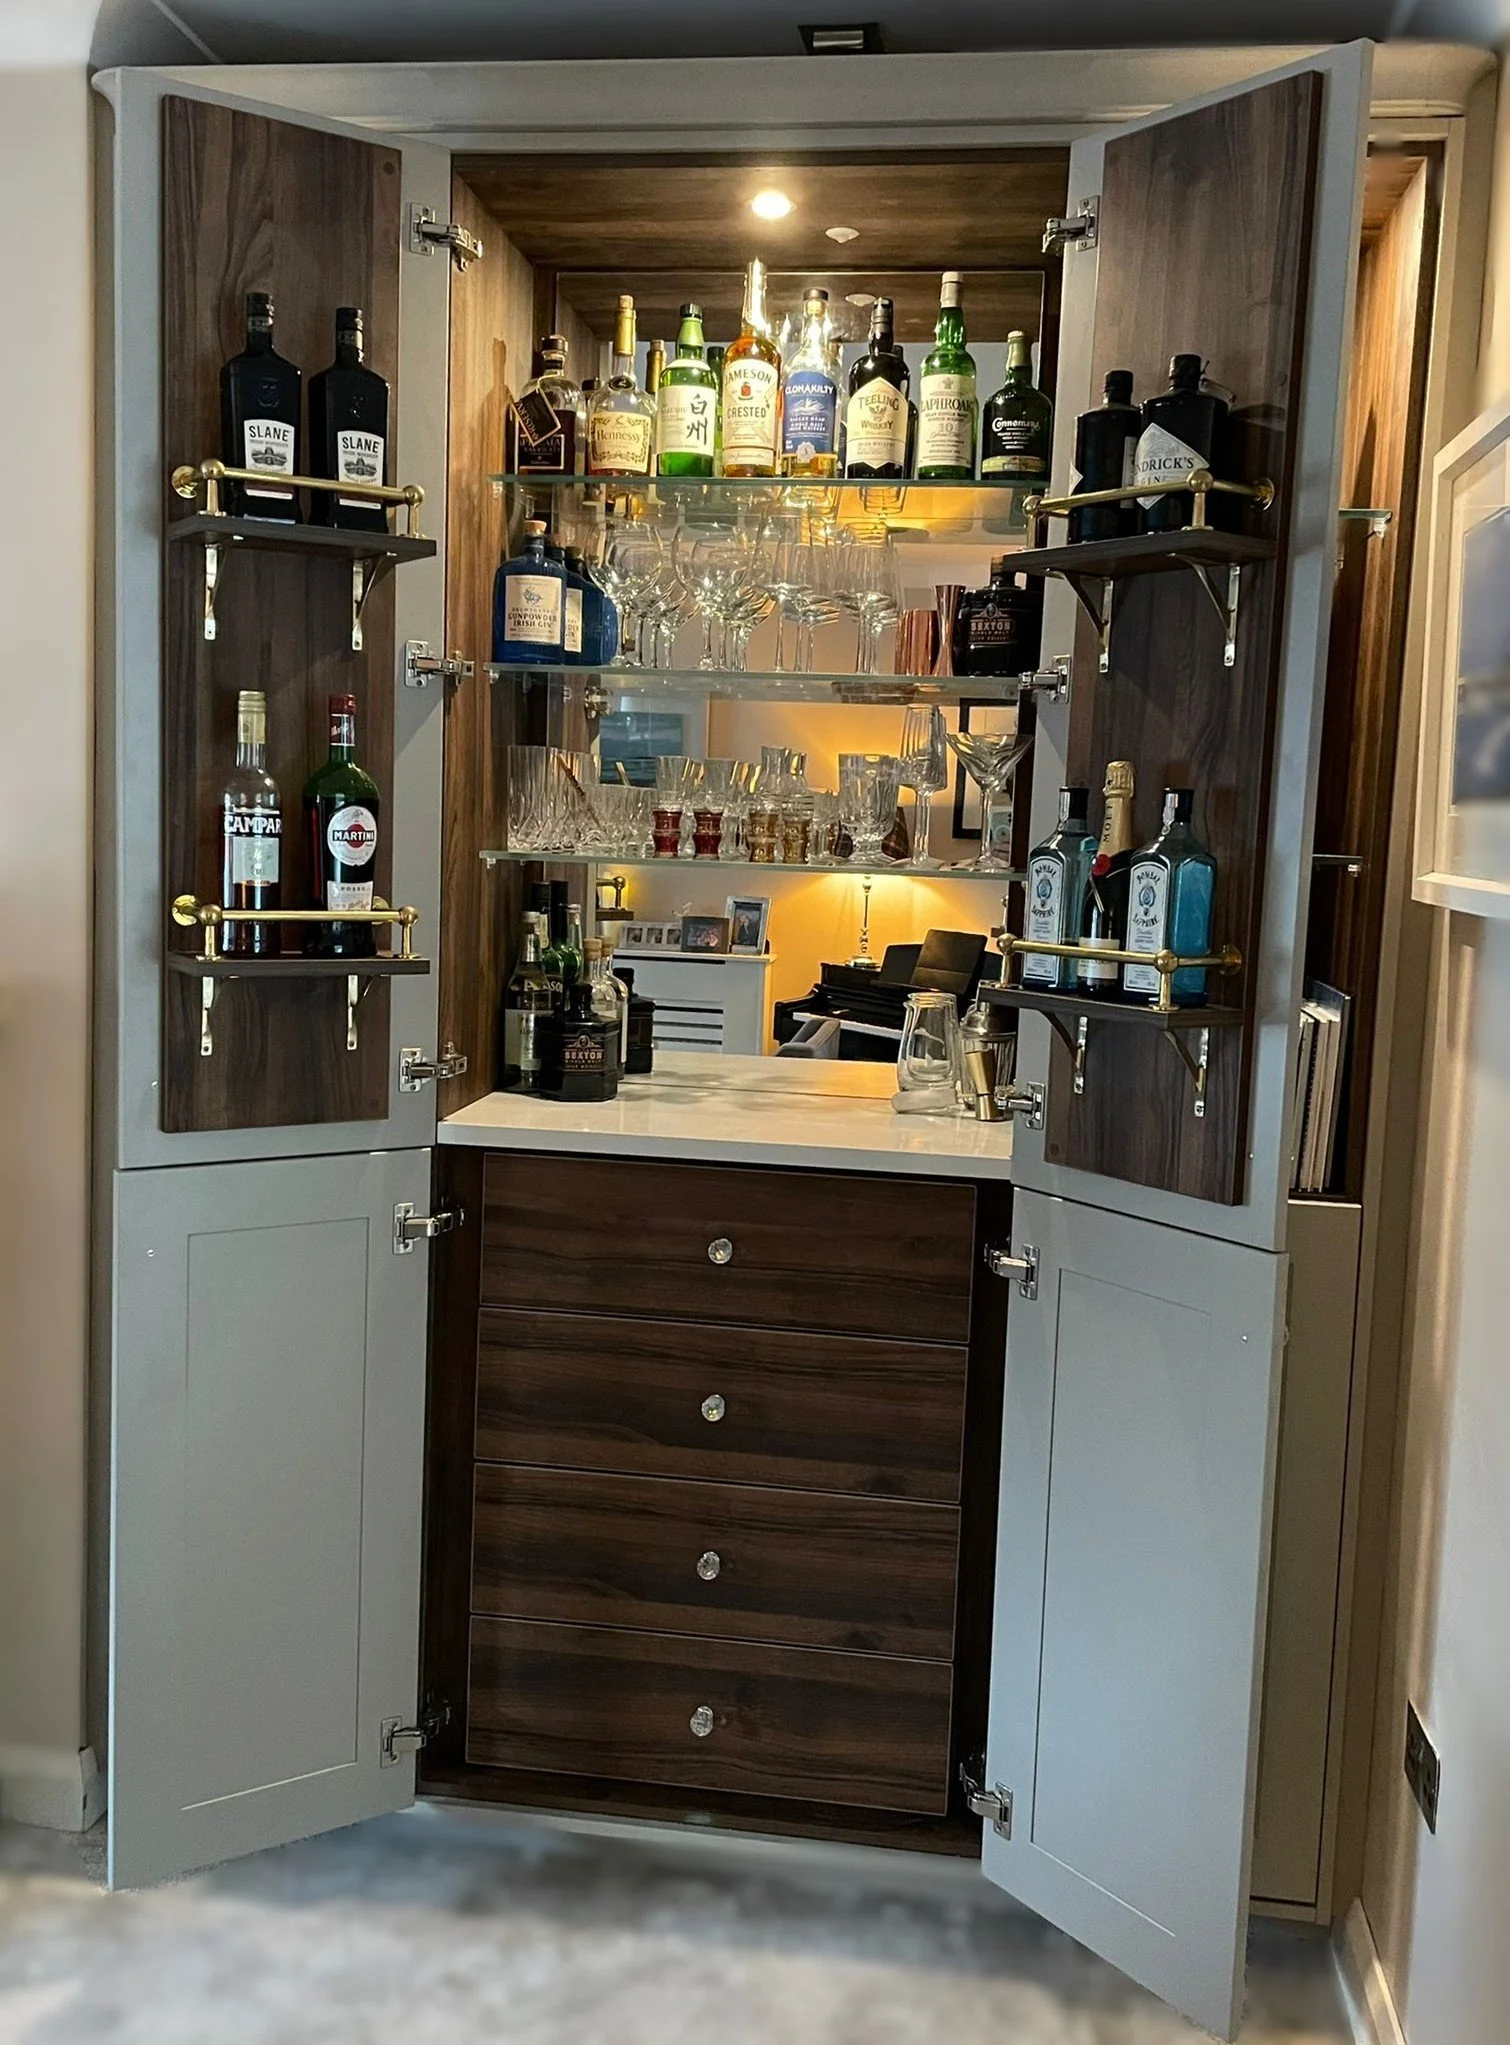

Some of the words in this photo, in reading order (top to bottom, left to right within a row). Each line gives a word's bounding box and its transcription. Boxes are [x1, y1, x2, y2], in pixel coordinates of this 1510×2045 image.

[725, 368, 772, 385] JAMESON
[858, 394, 900, 411] TEELING
[686, 393, 708, 446] 白州
[727, 406, 766, 419] CRESTED
[861, 420, 894, 430] WHISKEY
[248, 425, 290, 443] SLANE
[596, 429, 640, 444] Hennessy
[341, 436, 381, 454] SLANE
[507, 612, 558, 622] GUNPOWDER
[513, 619, 536, 628] IRISH
[537, 621, 553, 629] GIN
[970, 621, 1011, 631] SEXTON
[224, 814, 284, 834] CAMPAR
[333, 830, 375, 842] MARTINI
[564, 1050, 604, 1060] SEXTON
